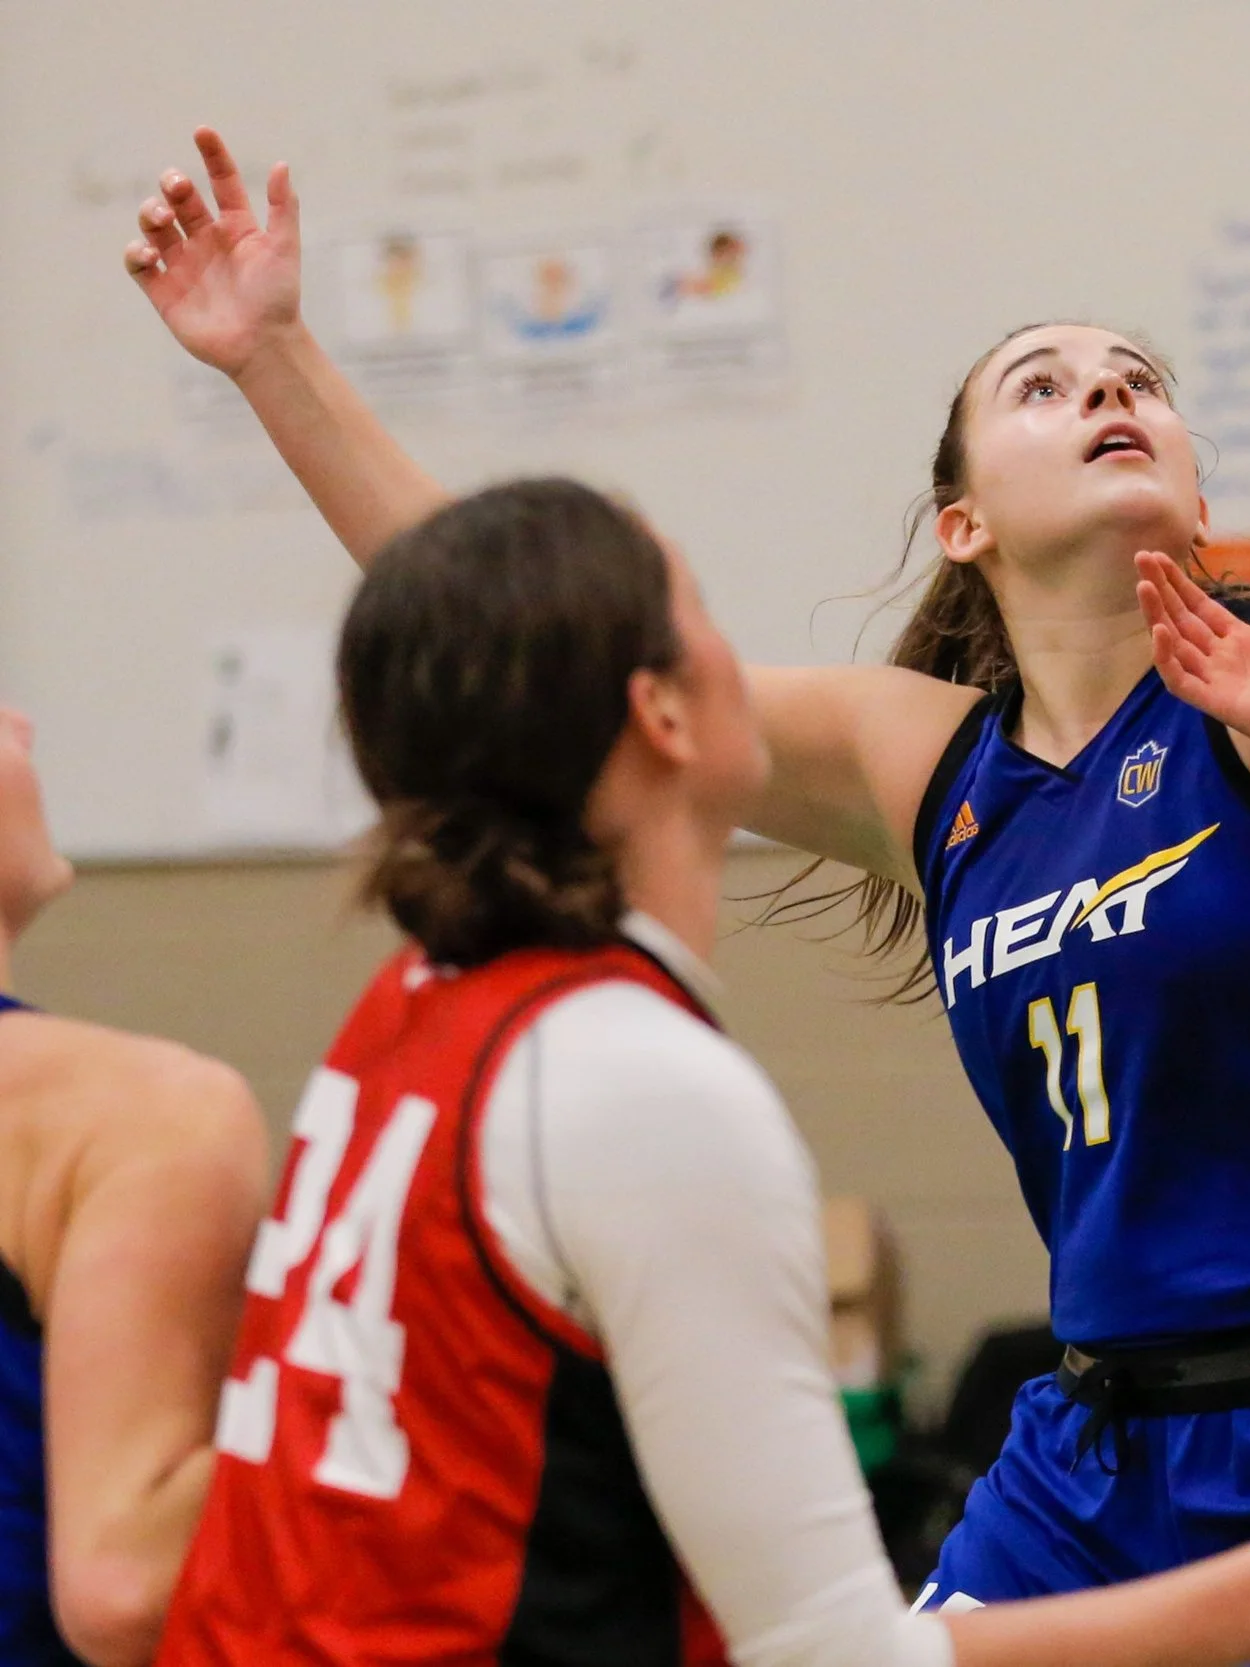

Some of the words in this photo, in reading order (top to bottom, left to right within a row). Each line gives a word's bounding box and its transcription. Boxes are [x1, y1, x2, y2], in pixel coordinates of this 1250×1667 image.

[1123, 759, 1160, 795] CW
[943, 856, 1190, 1009] HEAT
[1028, 981, 1110, 1151] 11
